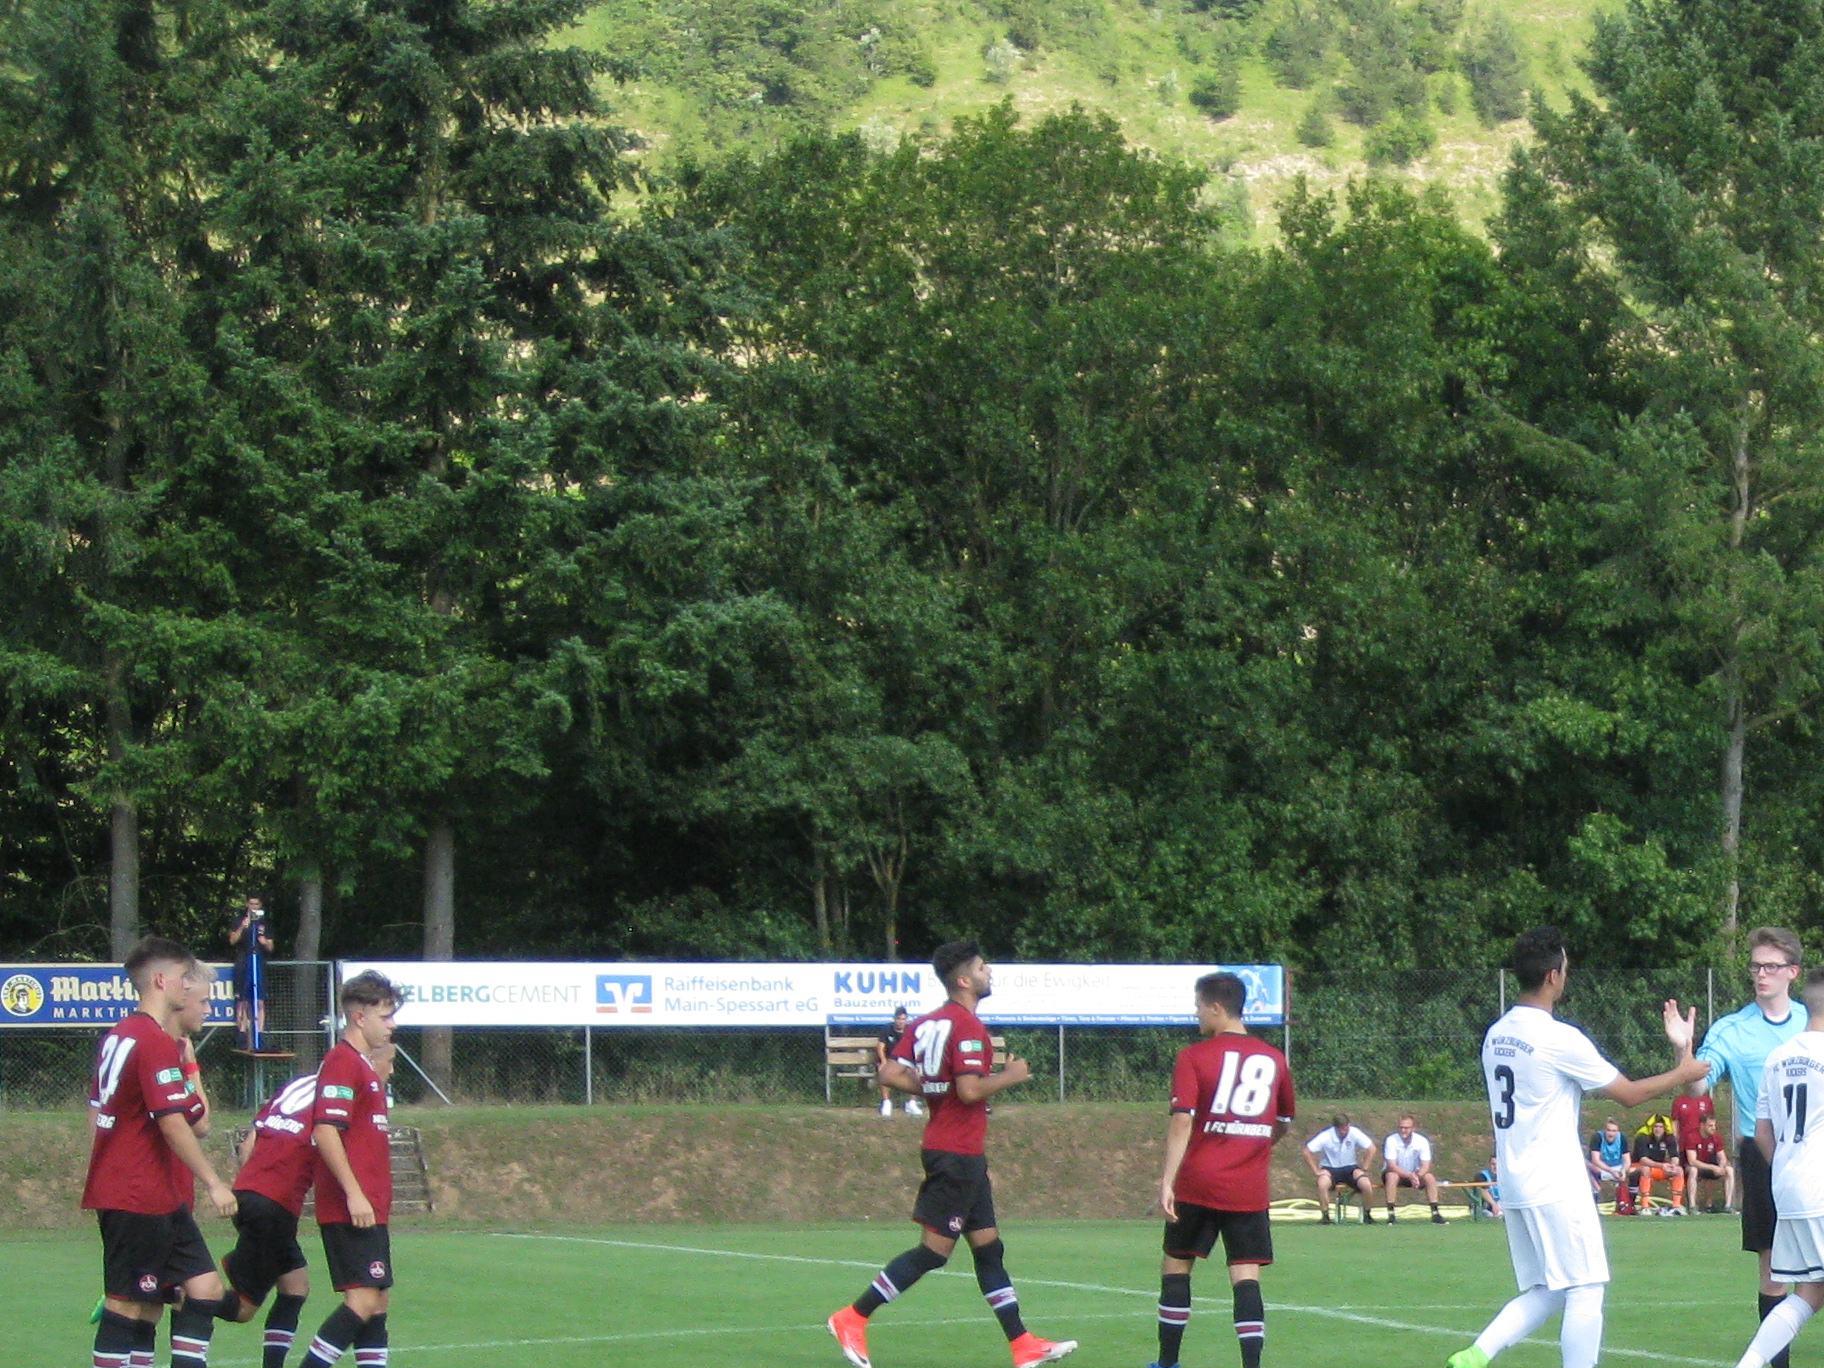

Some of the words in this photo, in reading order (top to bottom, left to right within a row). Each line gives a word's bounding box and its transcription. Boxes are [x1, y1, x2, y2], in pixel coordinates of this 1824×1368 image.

[665, 976, 794, 991] Raiffeisenbank
[834, 971, 922, 994] KUHN
[665, 998, 790, 1014] Main-Spessart
[796, 998, 818, 1011] eG
[834, 998, 921, 1009] Bauzentrum
[1210, 1051, 1277, 1117] 18
[1495, 1065, 1515, 1129] 3
[1779, 1083, 1807, 1144] 11
